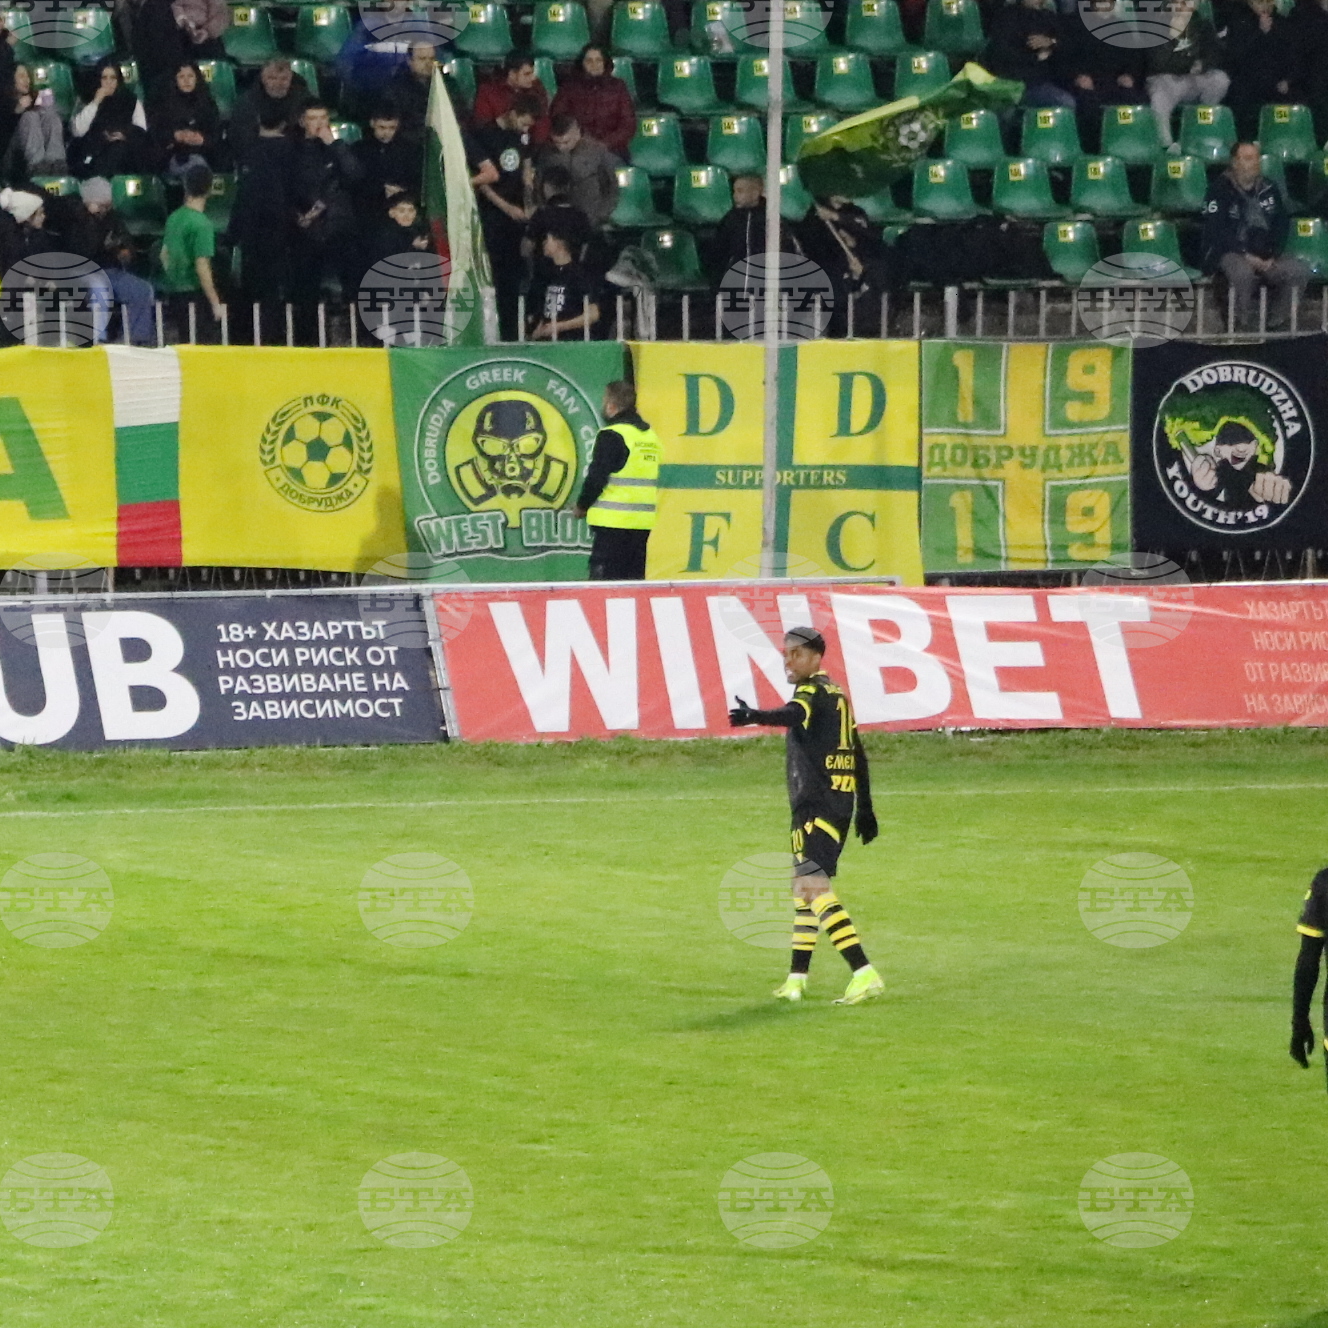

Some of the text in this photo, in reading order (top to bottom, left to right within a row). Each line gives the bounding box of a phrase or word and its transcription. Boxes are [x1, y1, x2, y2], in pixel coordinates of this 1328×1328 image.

[952, 348, 1113, 423] 1 9
[303, 394, 343, 409] ПФК
[678, 371, 887, 438] D D
[1181, 365, 1302, 440] DOBRUDZHA
[424, 399, 456, 485] DOBRUDJA
[465, 368, 527, 391] GREEK
[546, 379, 580, 415] FAN
[926, 440, 1125, 473] ДОБРУДЖА
[279, 483, 356, 510] ДОБРУДЖА
[417, 511, 507, 557] WEST
[679, 510, 876, 573] F C
[949, 489, 1112, 564] 1 9
[217, 621, 387, 643] 18+ ХАЗАРТЪТ
[1252, 631, 1298, 651] НОСИ
[217, 647, 399, 669] НОСИ РИСК ОТ
[489, 594, 1151, 733] WINBET
[1244, 662, 1264, 682] ОТ
[219, 673, 409, 695] РАЗВИВАНЕ НА
[232, 698, 404, 720] ЗАВИСИМОСТ
[1245, 693, 1270, 713] НА
